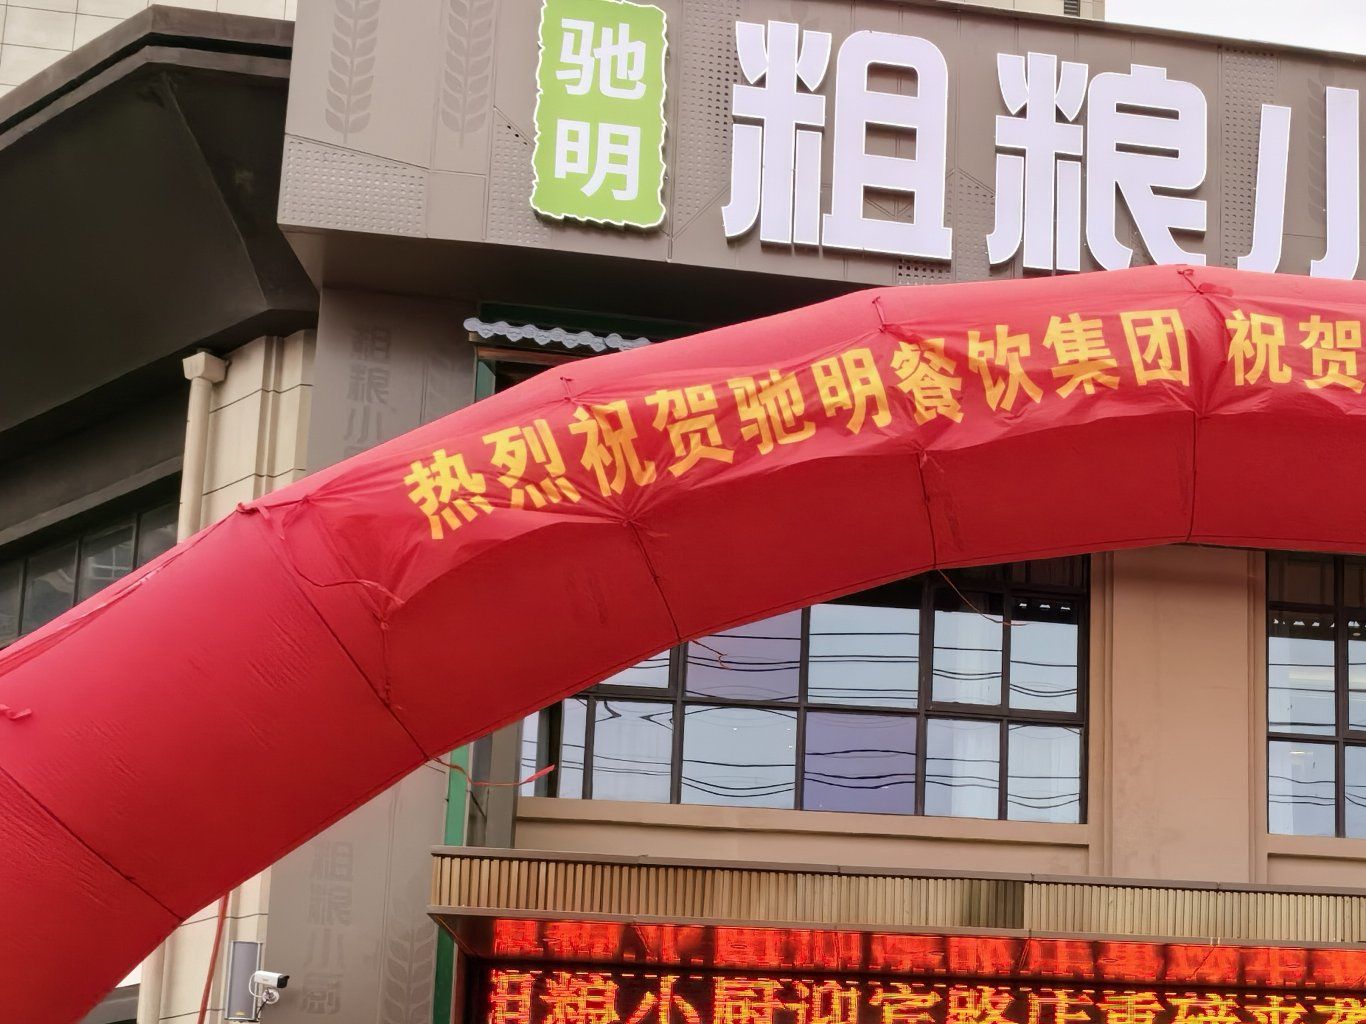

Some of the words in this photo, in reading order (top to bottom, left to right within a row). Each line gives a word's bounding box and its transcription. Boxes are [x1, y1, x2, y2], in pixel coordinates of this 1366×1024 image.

[555, 17, 648, 203] 驰明
[404, 308, 1190, 540] 热烈祝贺驰明餐饮集团
